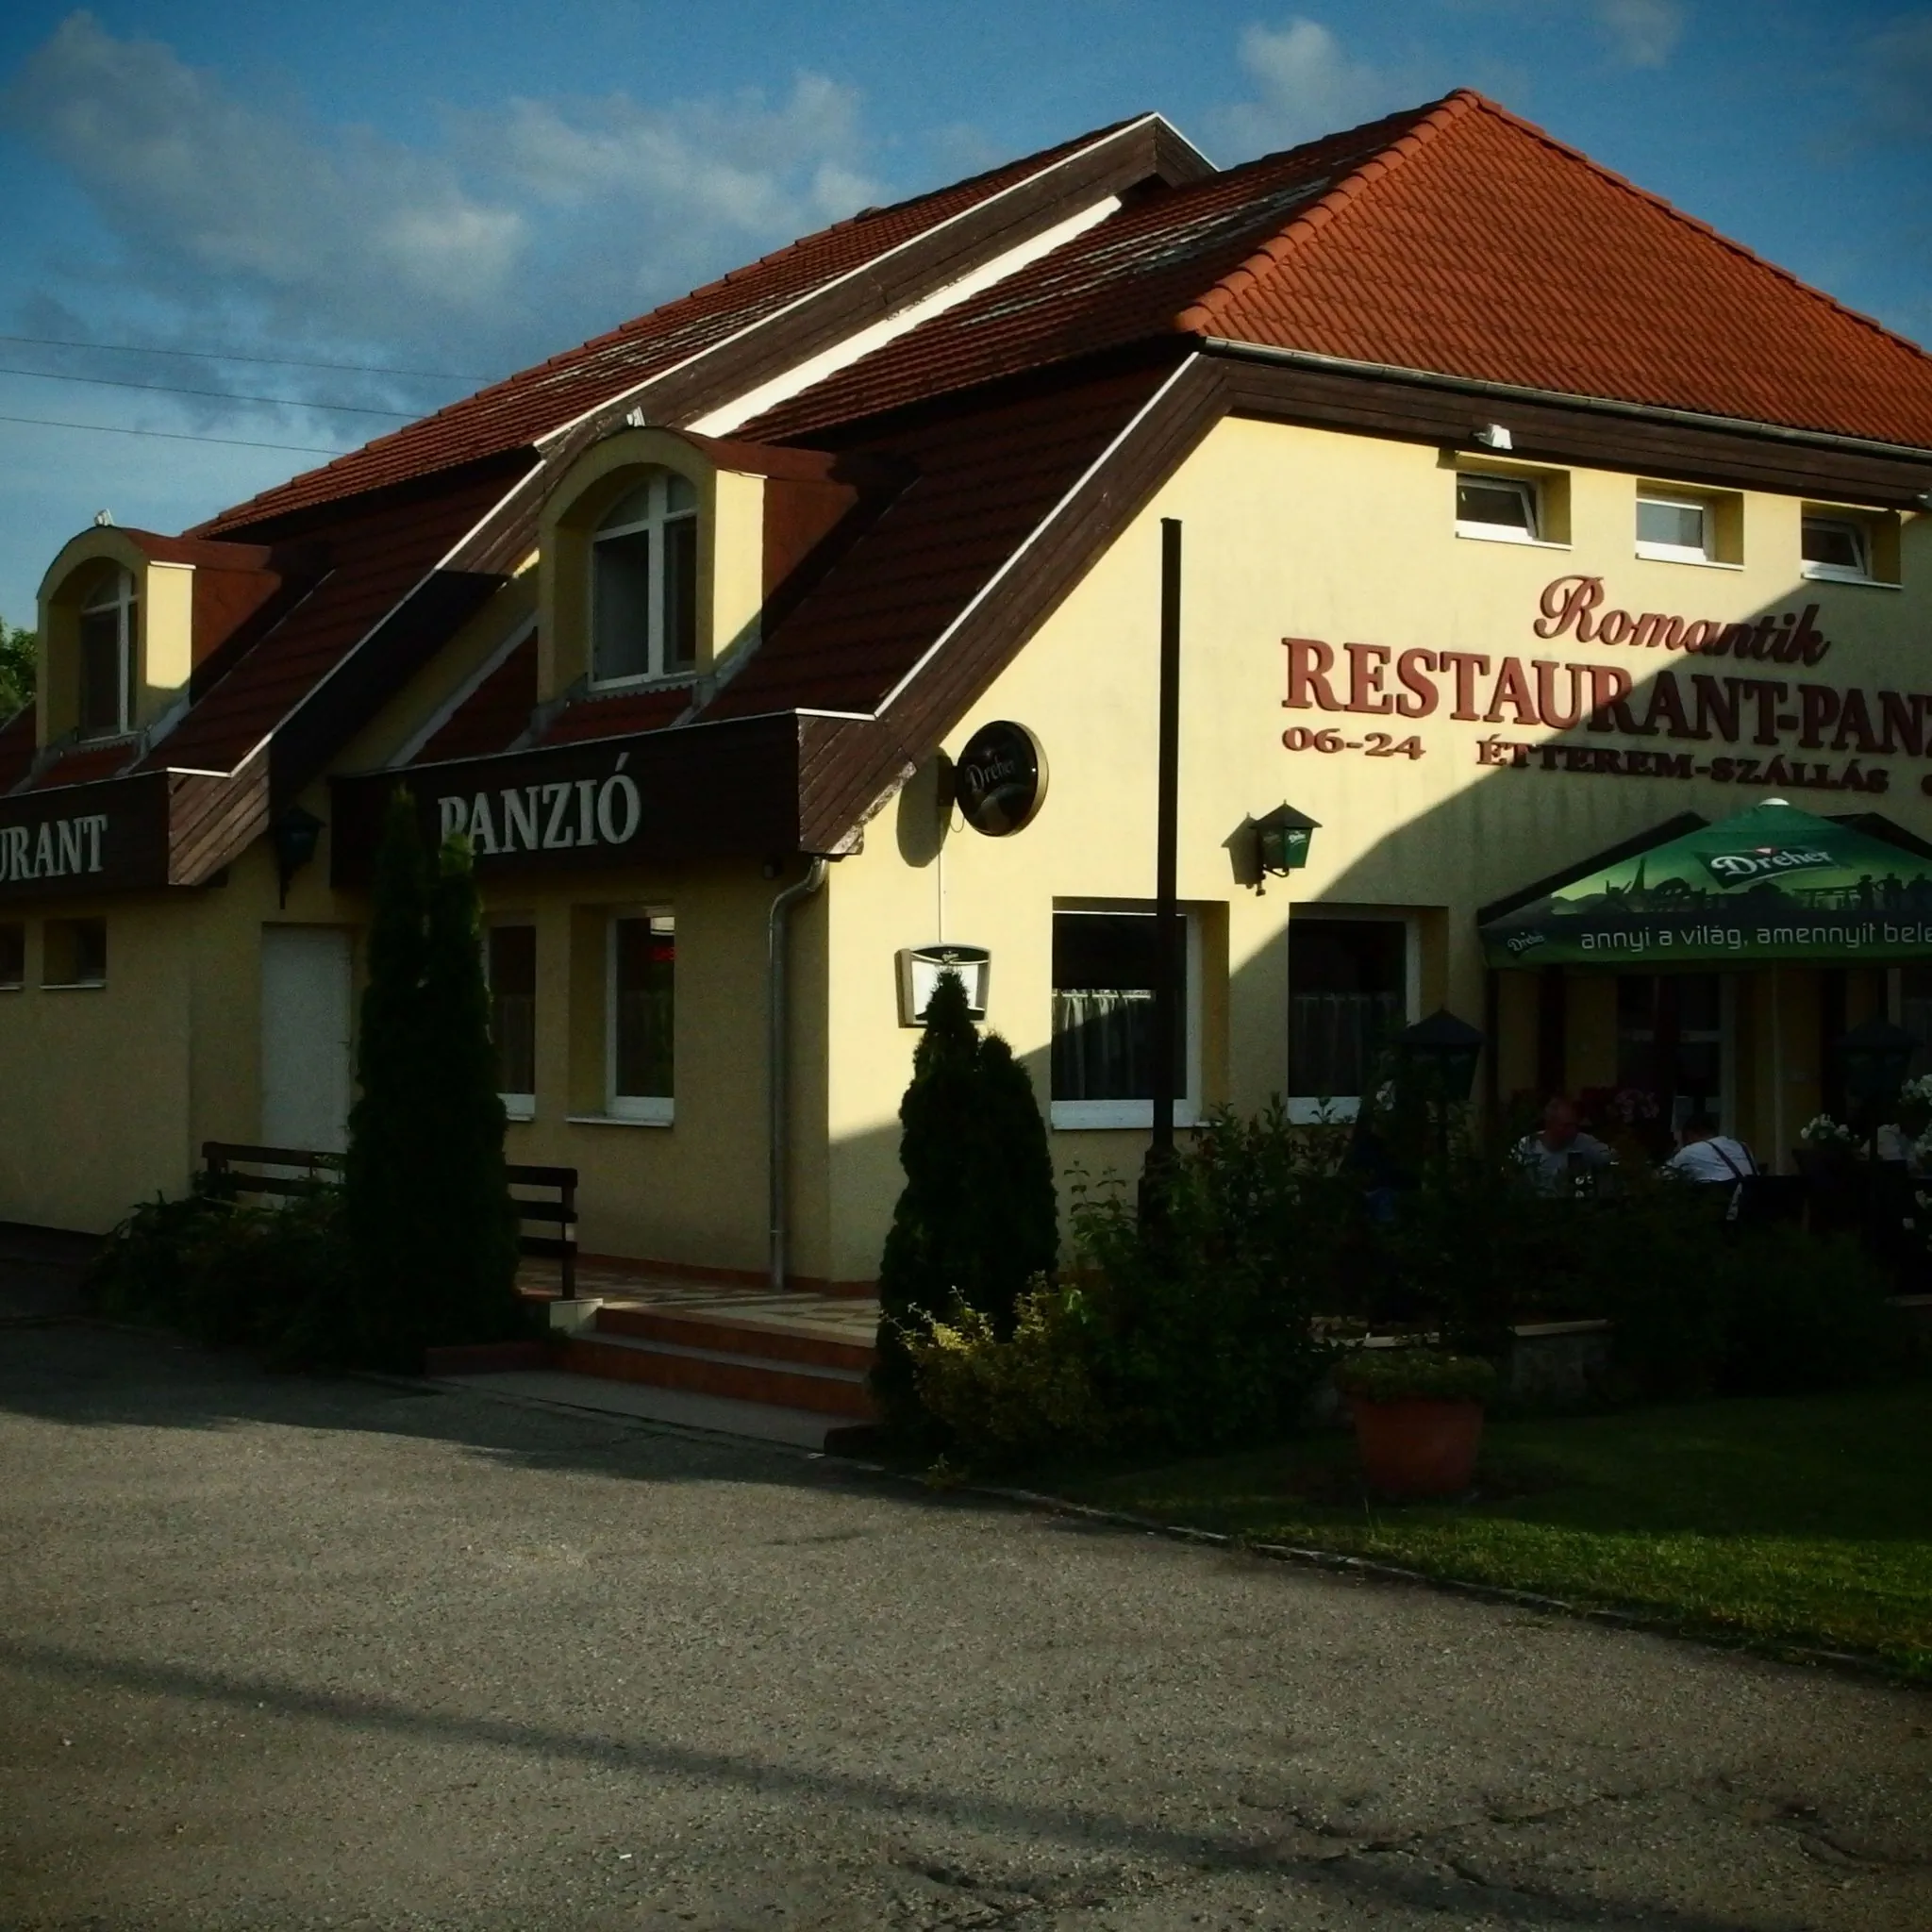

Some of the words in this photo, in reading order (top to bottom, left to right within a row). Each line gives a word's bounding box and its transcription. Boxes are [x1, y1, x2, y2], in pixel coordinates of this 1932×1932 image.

[1533, 575, 1833, 666] Romantik
[1281, 637, 1932, 758] RESTAURANT-PAN
[1281, 726, 1426, 760] 06-24
[1476, 734, 1889, 793] ÉTTEREM-SZÁLLÁS
[438, 752, 641, 858] PANZIÓ
[1710, 850, 1834, 877] Dreher
[1580, 926, 1651, 953] annyi
[1658, 929, 1674, 946] a
[1679, 924, 1749, 951] világ,
[1756, 922, 1876, 950] amennyit
